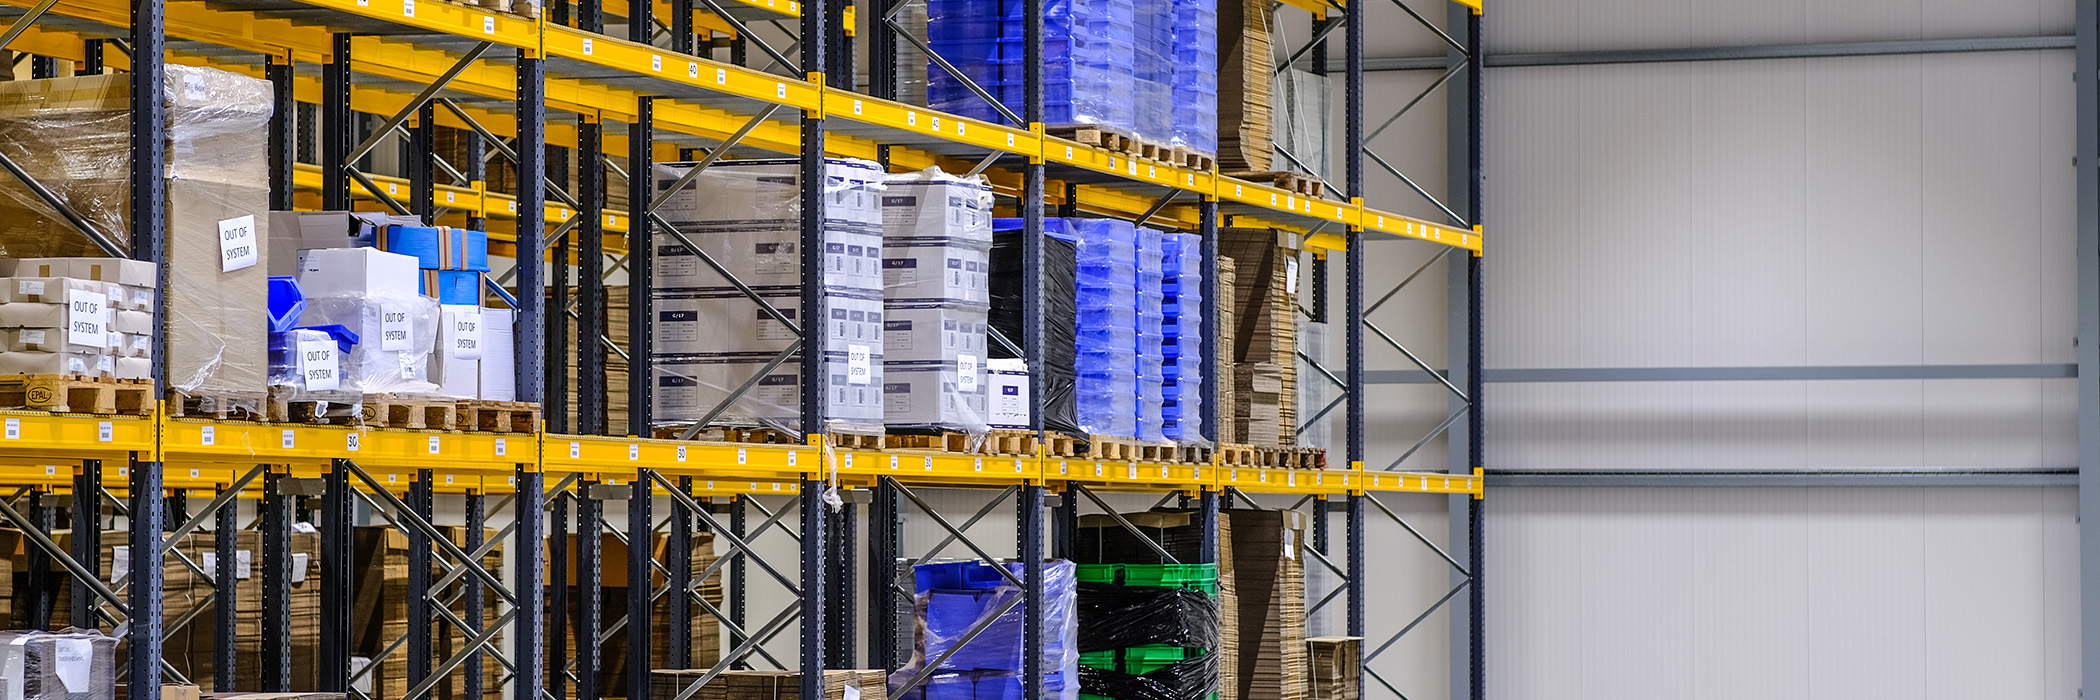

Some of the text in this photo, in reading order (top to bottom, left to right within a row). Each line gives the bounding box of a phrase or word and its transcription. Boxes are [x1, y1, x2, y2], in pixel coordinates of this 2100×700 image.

[690, 65, 696, 74] 40
[224, 226, 247, 240] OUT OF
[226, 245, 250, 260] SYSTEM
[74, 301, 98, 314] OUT OF
[385, 313, 404, 322] OUT OF
[74, 321, 98, 334] SYSTEM
[458, 322, 475, 332] OUT OF
[385, 330, 406, 340] SYSTEM
[457, 339, 476, 349] SYSTEM
[307, 351, 330, 361] OUT OF
[309, 369, 332, 380] SYSTEM
[32, 390, 47, 400] EPAL
[348, 436, 357, 447] 30
